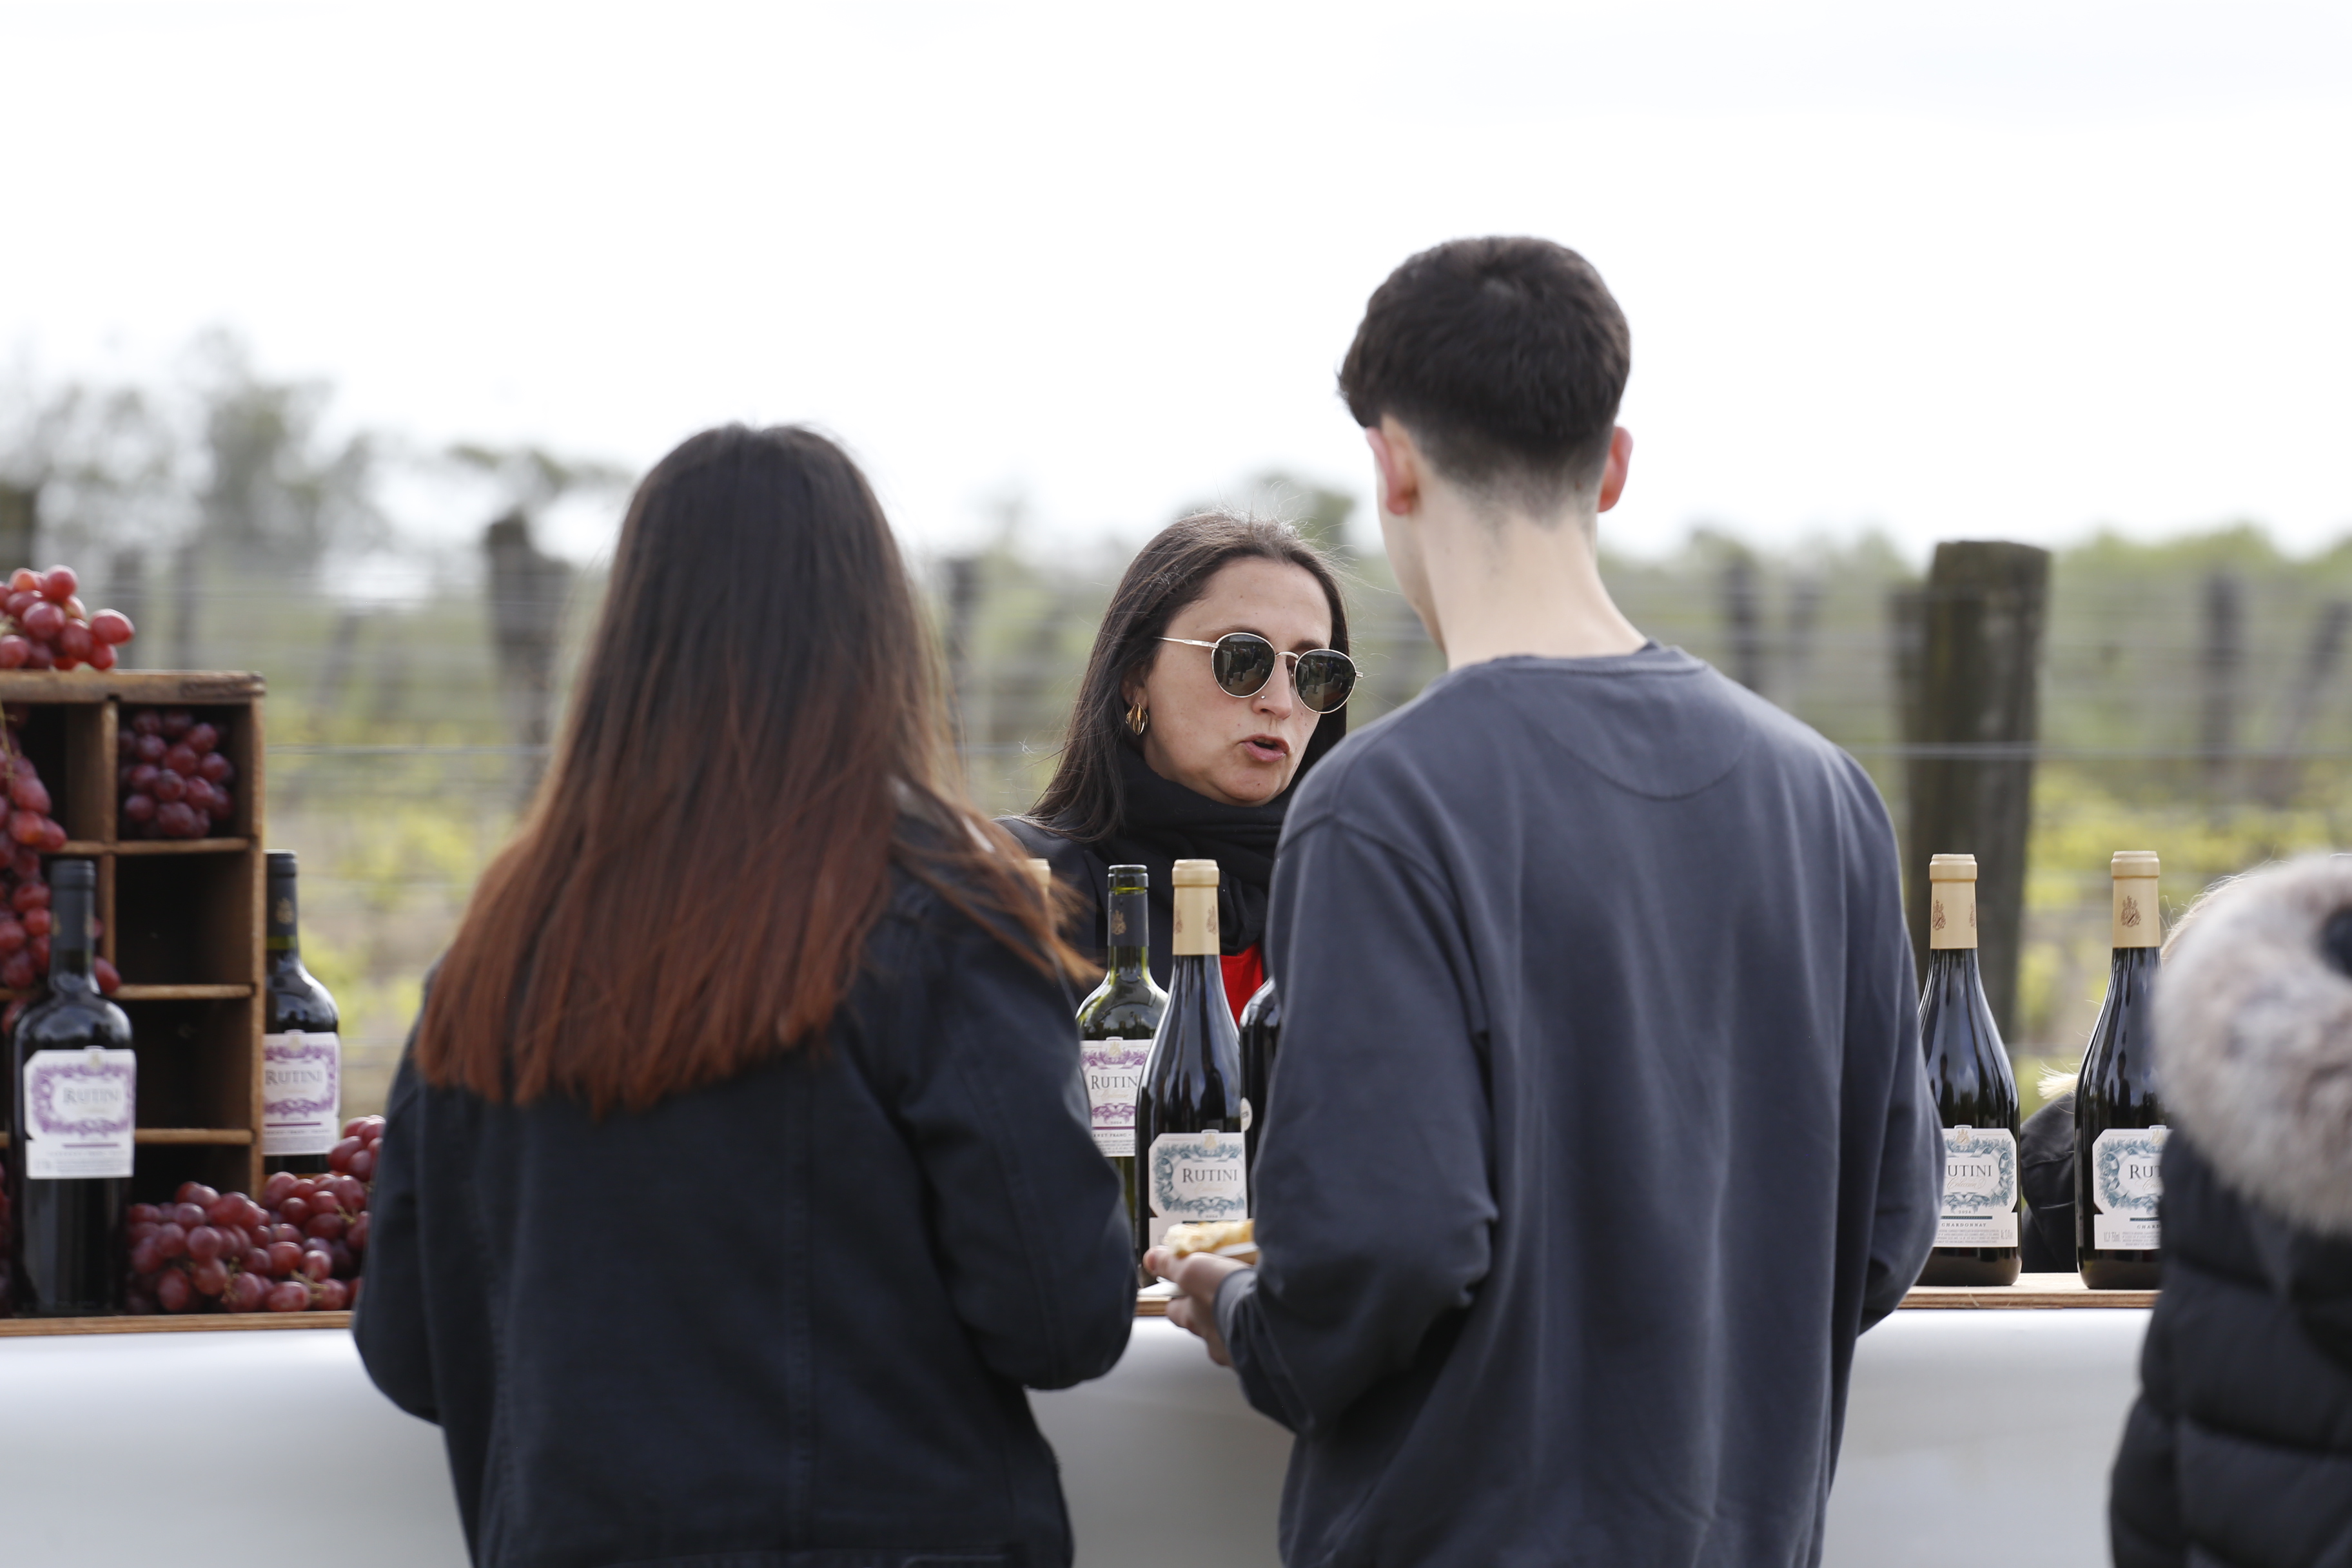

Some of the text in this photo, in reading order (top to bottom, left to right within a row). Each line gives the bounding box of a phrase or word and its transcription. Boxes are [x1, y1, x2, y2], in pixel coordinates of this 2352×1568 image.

[1091, 1075, 1139, 1090] RUTIN
[1182, 1168, 1238, 1183] RUTINI
[1947, 1164, 1992, 1177] UTINI
[2128, 1164, 2162, 1180] RUT
